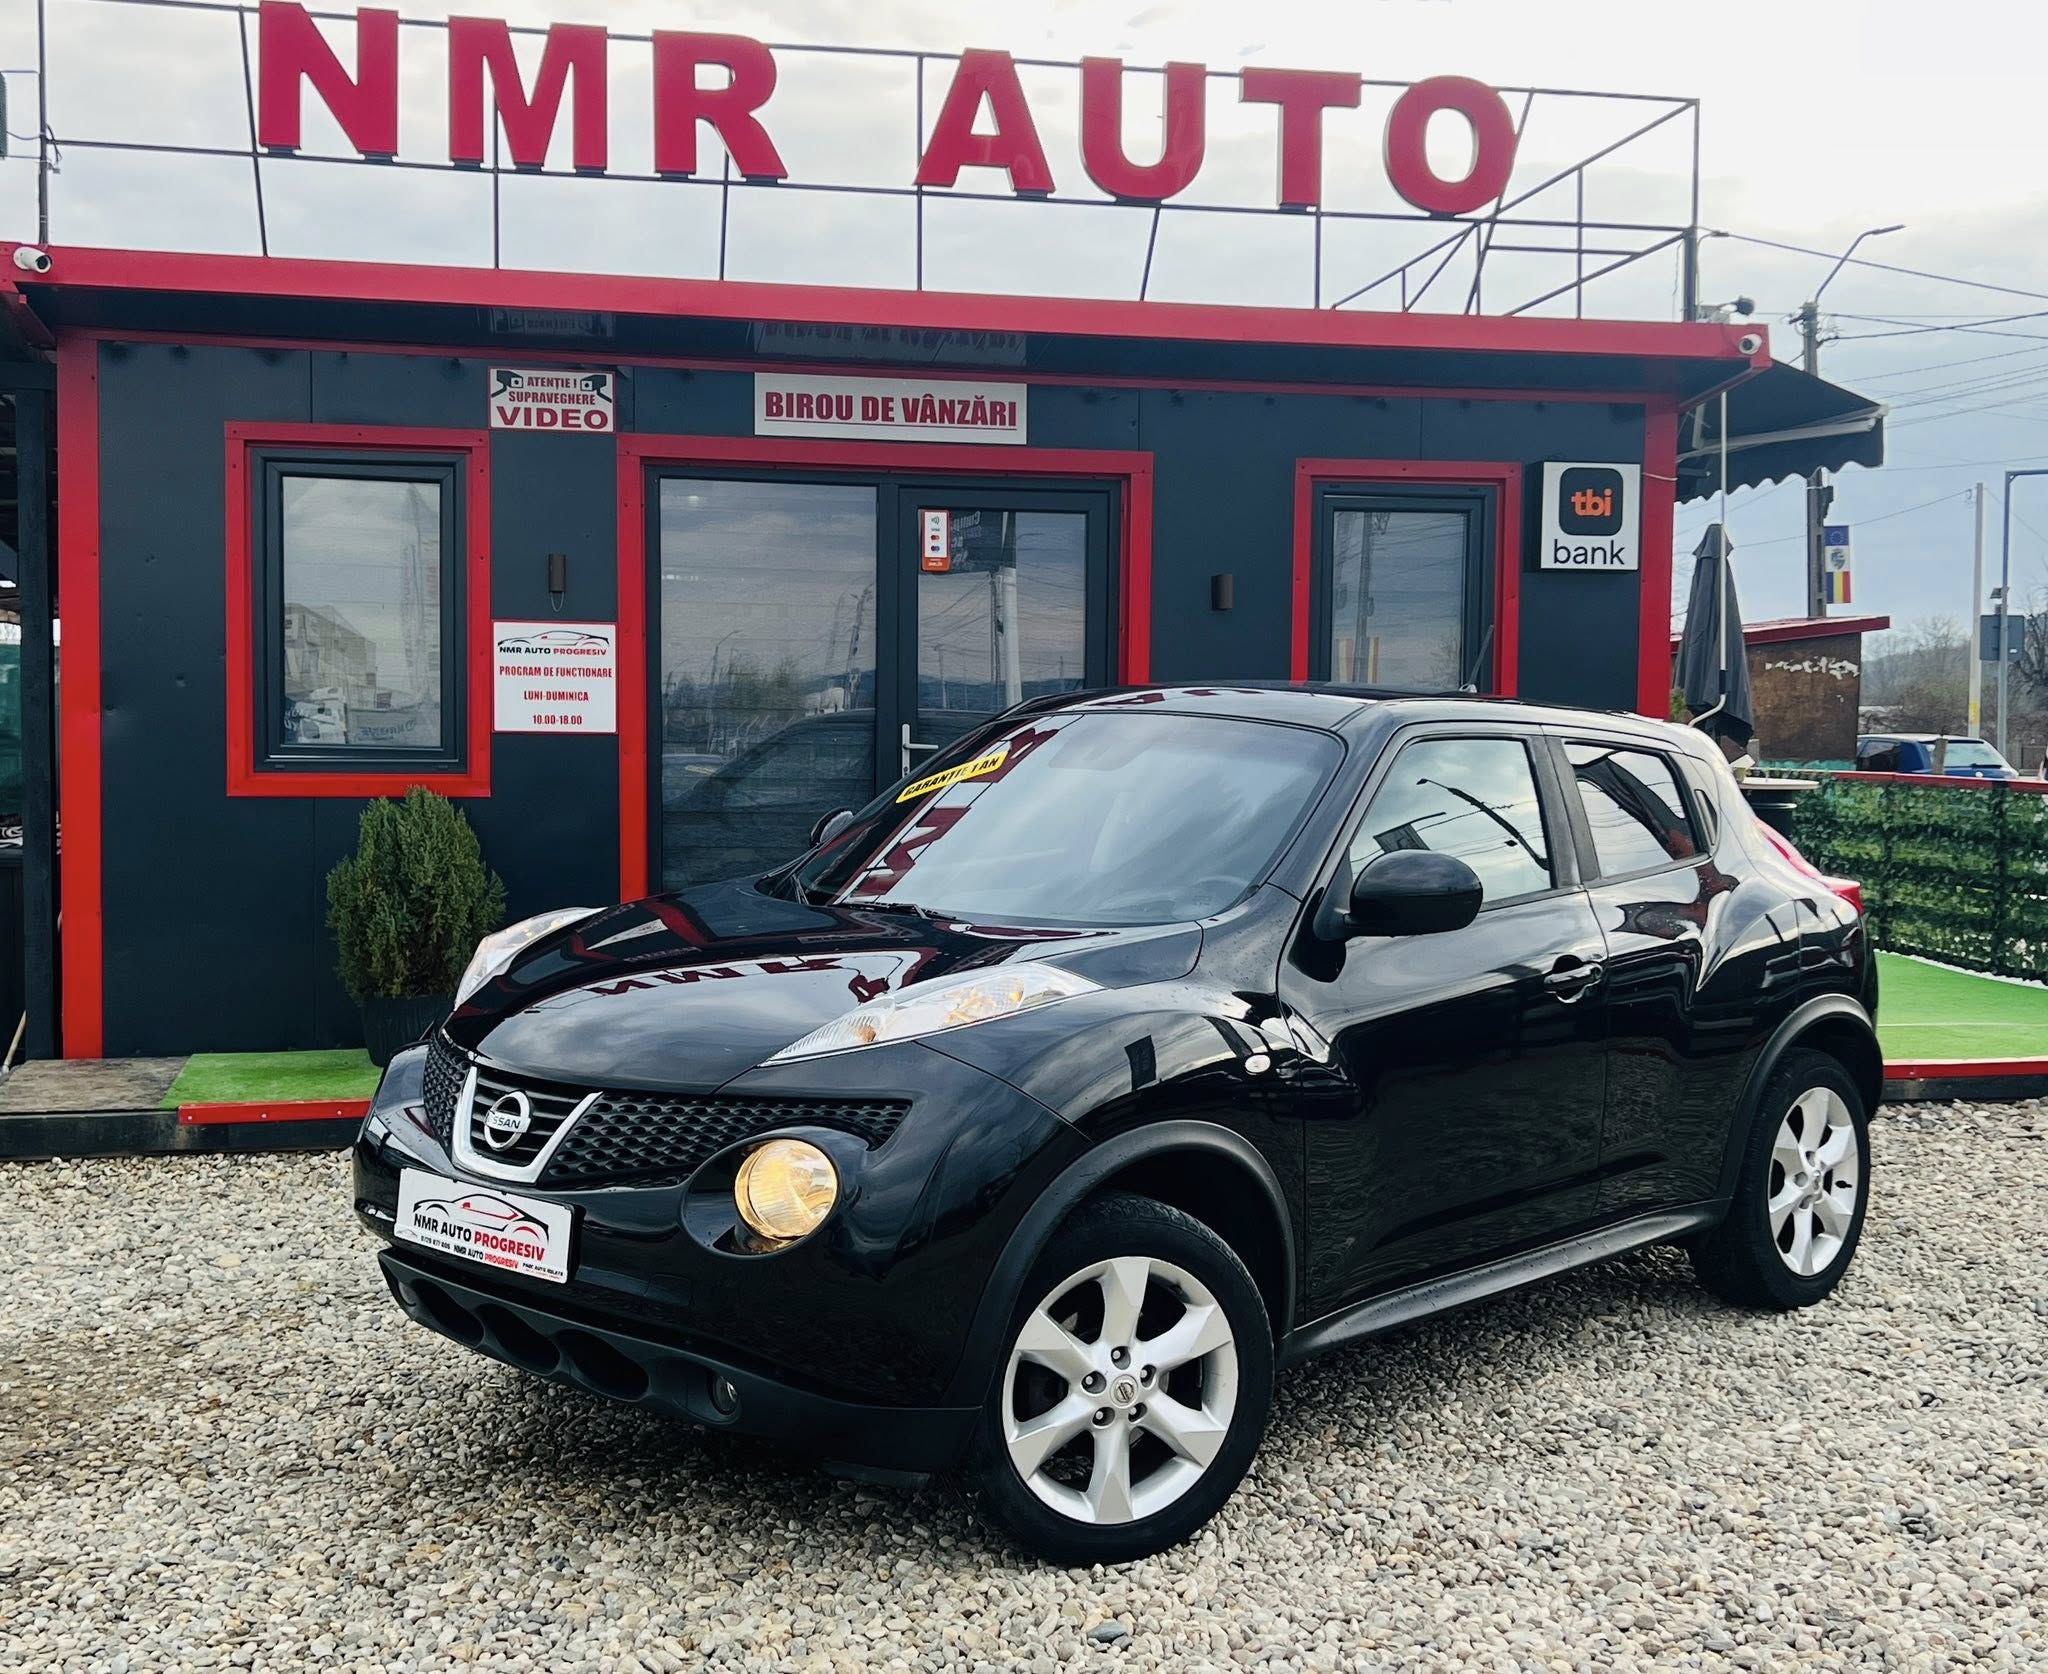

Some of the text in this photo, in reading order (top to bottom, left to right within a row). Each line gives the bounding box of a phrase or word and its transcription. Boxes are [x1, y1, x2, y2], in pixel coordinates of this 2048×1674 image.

[258, 1, 1517, 215] NMR AUTO
[508, 391, 596, 405] SUPRAVEGHERE
[765, 391, 1017, 427] BIROU DE VÂNZĂRI
[496, 406, 609, 430] VIDEO
[1571, 488, 1613, 516] tbi
[1553, 538, 1625, 565] bank
[499, 646, 607, 656] NMR AUTO PROGRESIV
[499, 666, 541, 676] PROGRAM
[543, 667, 554, 677] DE
[979, 756, 1000, 771] AN
[413, 1213, 546, 1262] NMR AUTO PROGRESIV
[467, 1248, 484, 1260] AUTO
[484, 1253, 519, 1269] PROGRESIV
